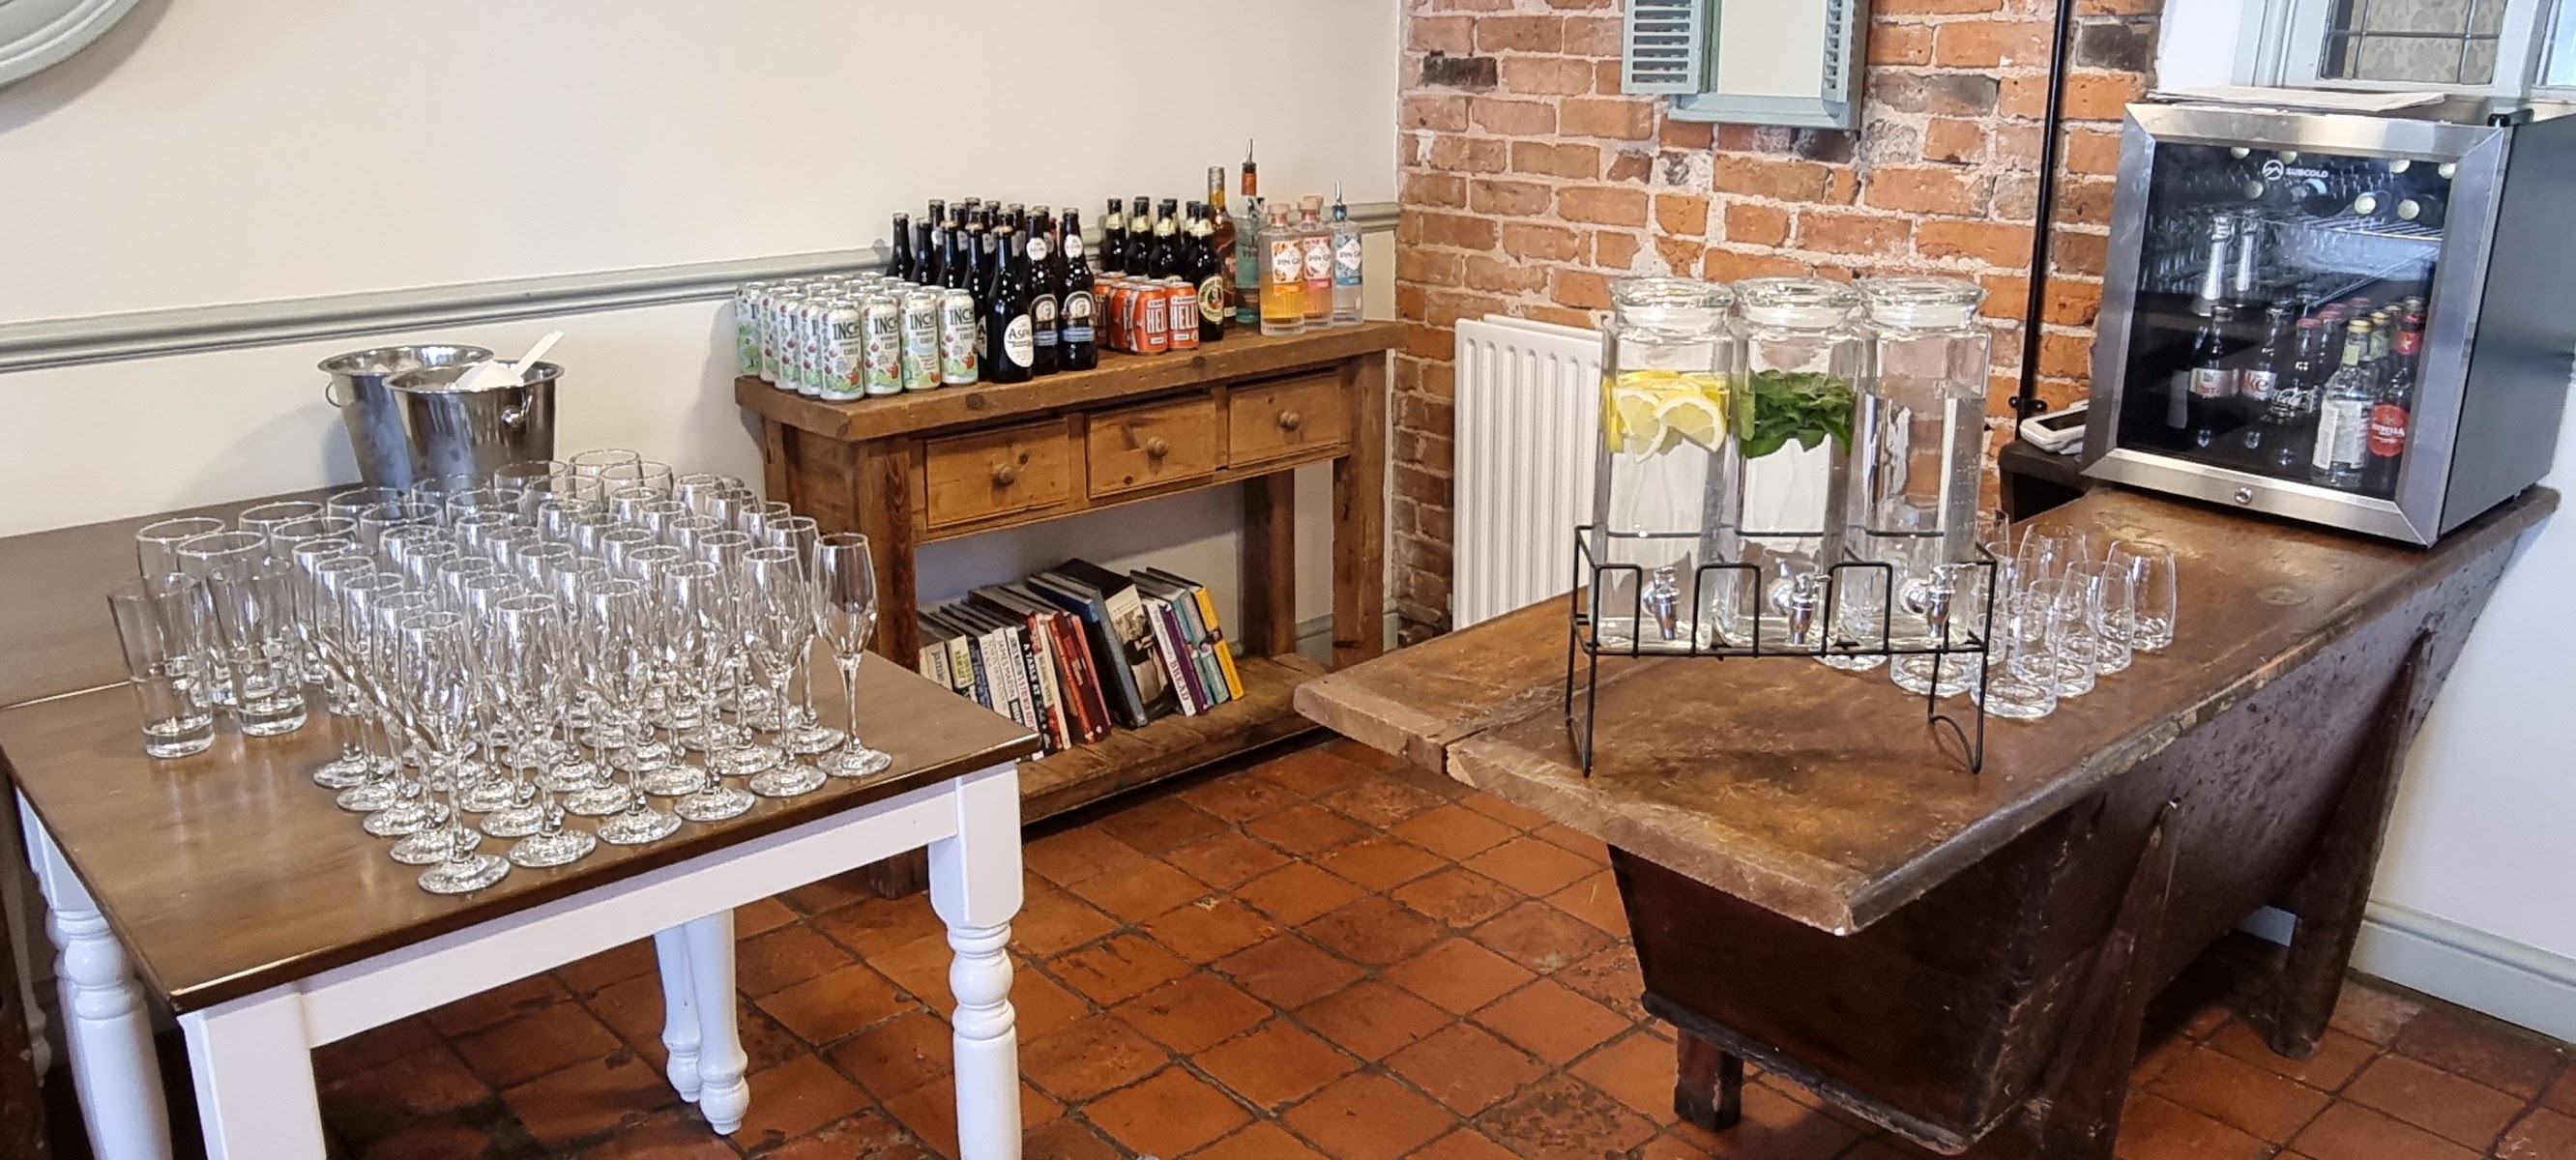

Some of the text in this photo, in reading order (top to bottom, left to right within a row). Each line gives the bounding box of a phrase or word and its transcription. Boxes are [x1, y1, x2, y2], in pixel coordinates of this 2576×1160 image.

[2286, 167, 2328, 178] SUBCOLD
[1146, 308, 1166, 334] HEL
[1170, 304, 1198, 331] HELL
[1009, 329, 1031, 339] ASP
[1023, 652, 1038, 682] TABLE
[1031, 682, 1040, 696] AT
[1170, 660, 1190, 701] BREAD
